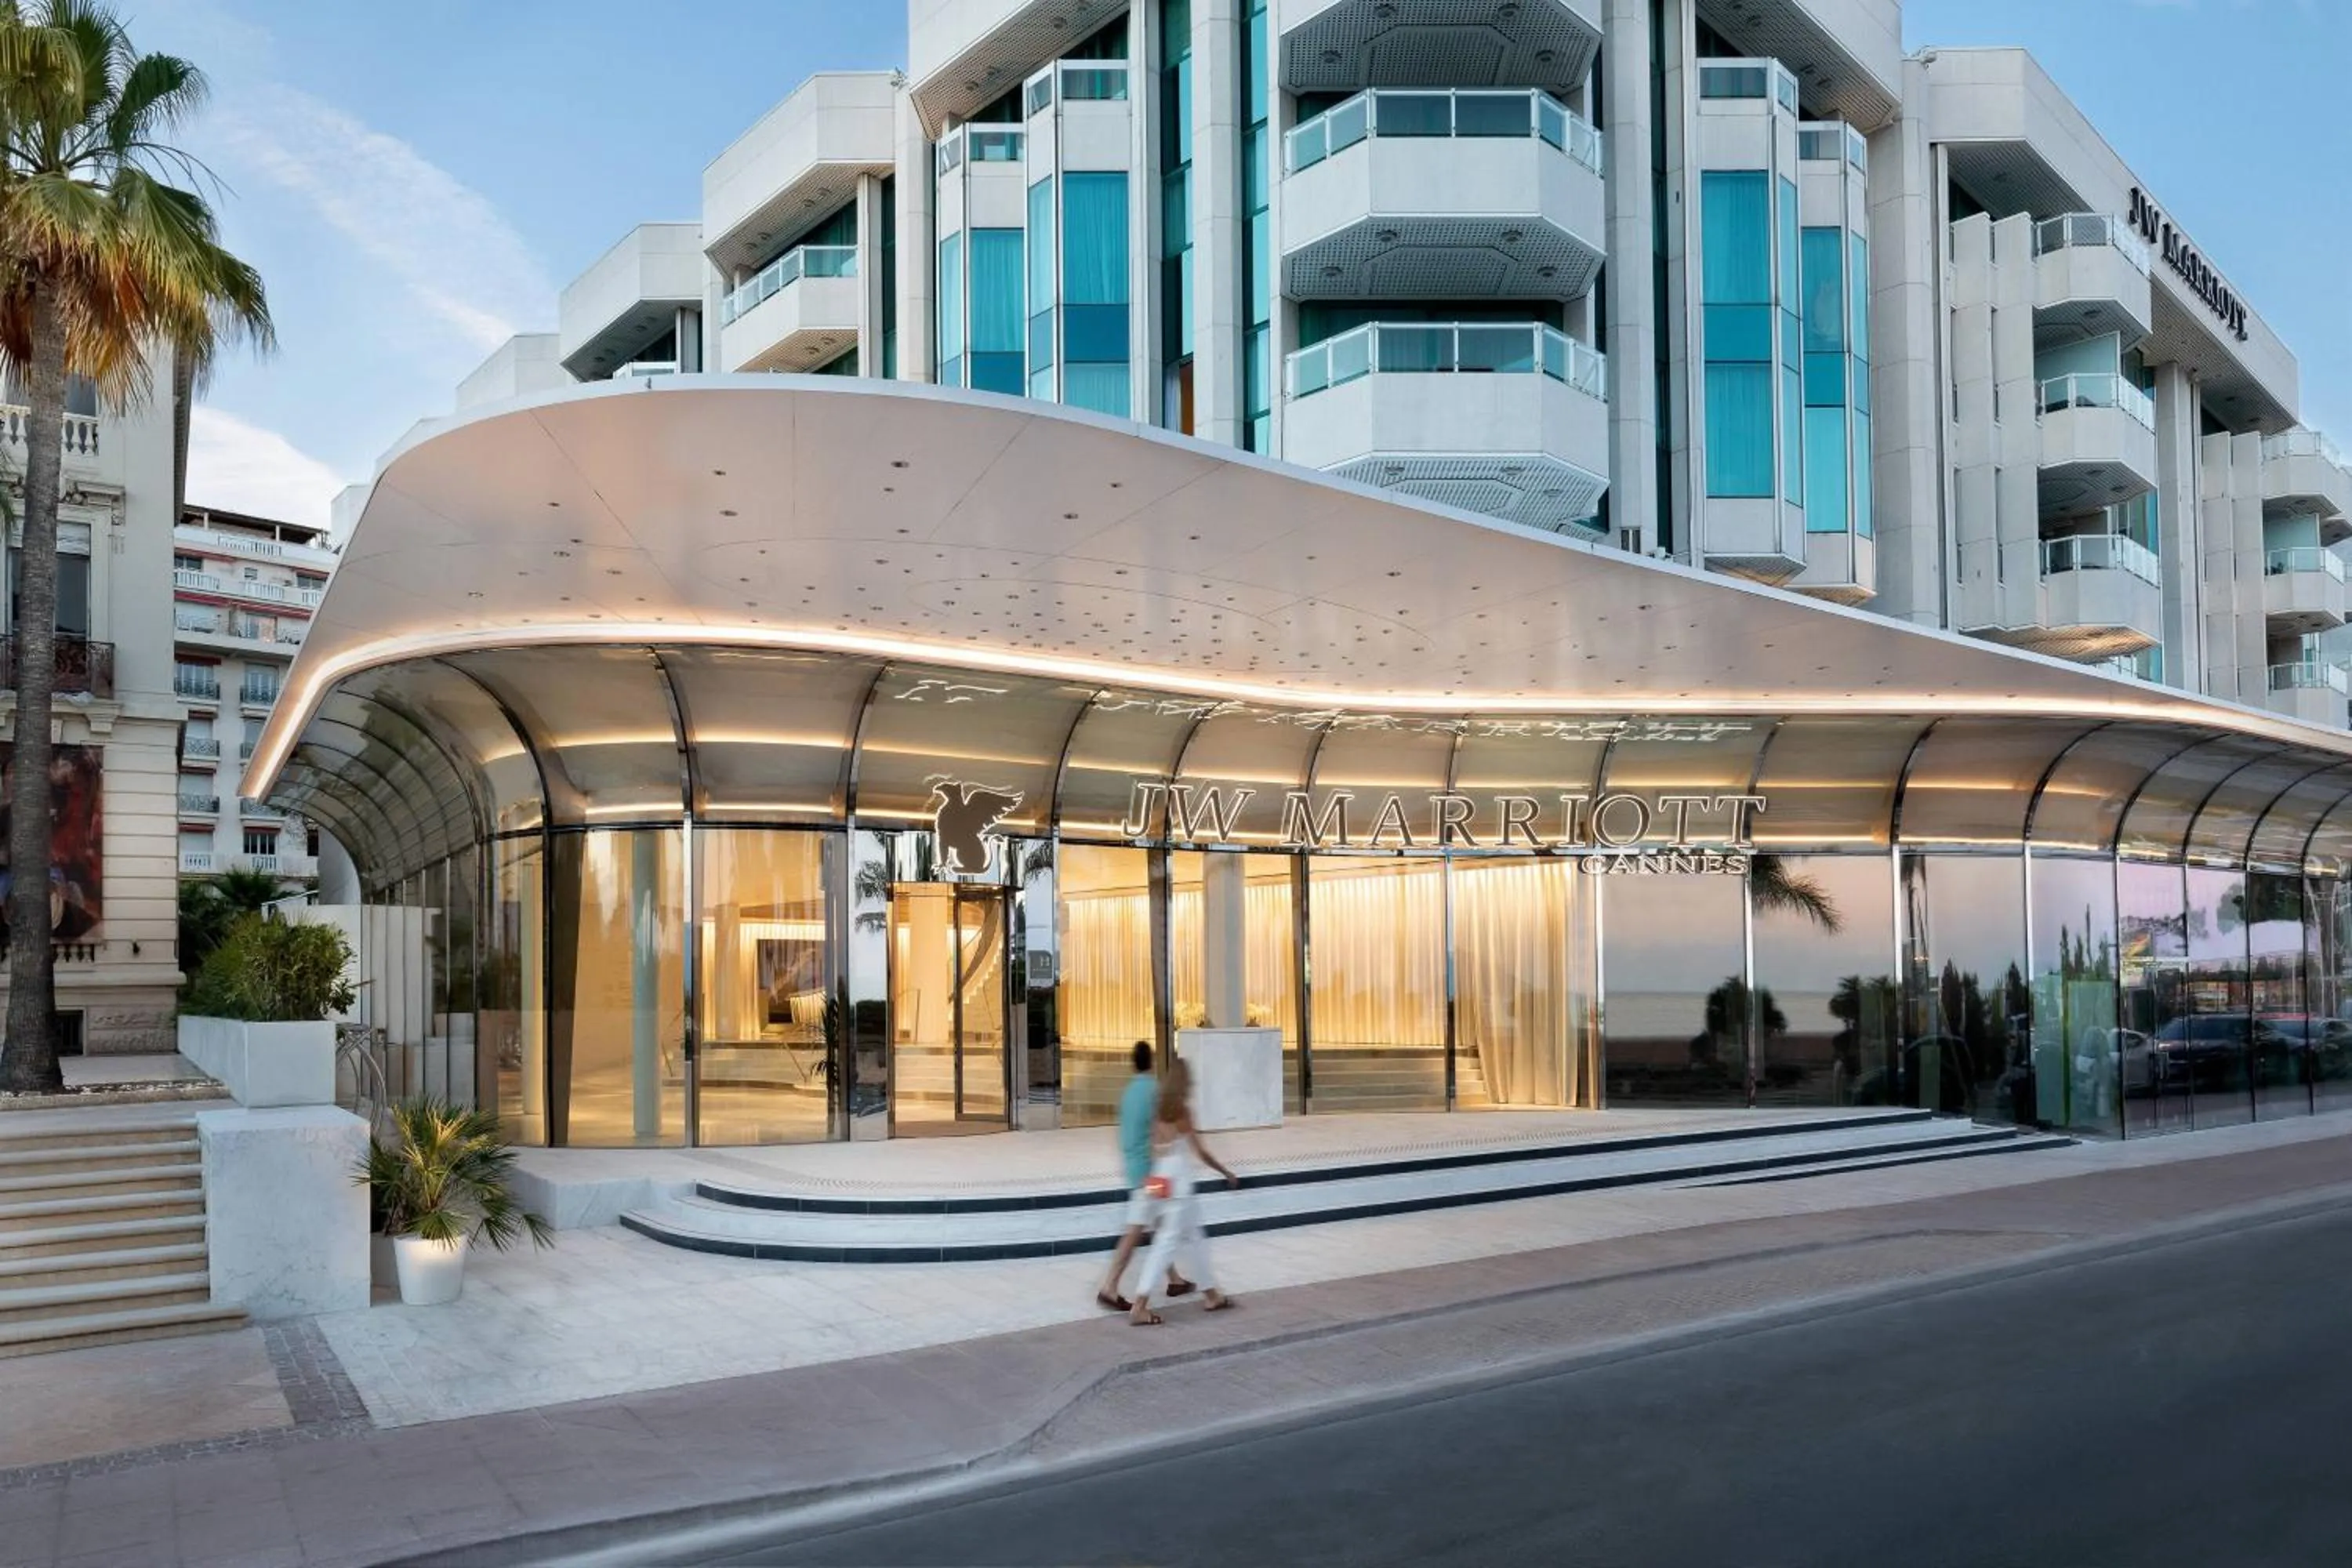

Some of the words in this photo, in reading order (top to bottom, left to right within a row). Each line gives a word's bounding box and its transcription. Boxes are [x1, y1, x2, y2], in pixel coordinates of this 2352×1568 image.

[2128, 186, 2160, 244] JW
[2161, 222, 2248, 342] MARRIOTT
[1121, 782, 1257, 843] JW
[1279, 789, 1766, 849] MARRIOTT
[1580, 854, 1748, 875] CANNES
